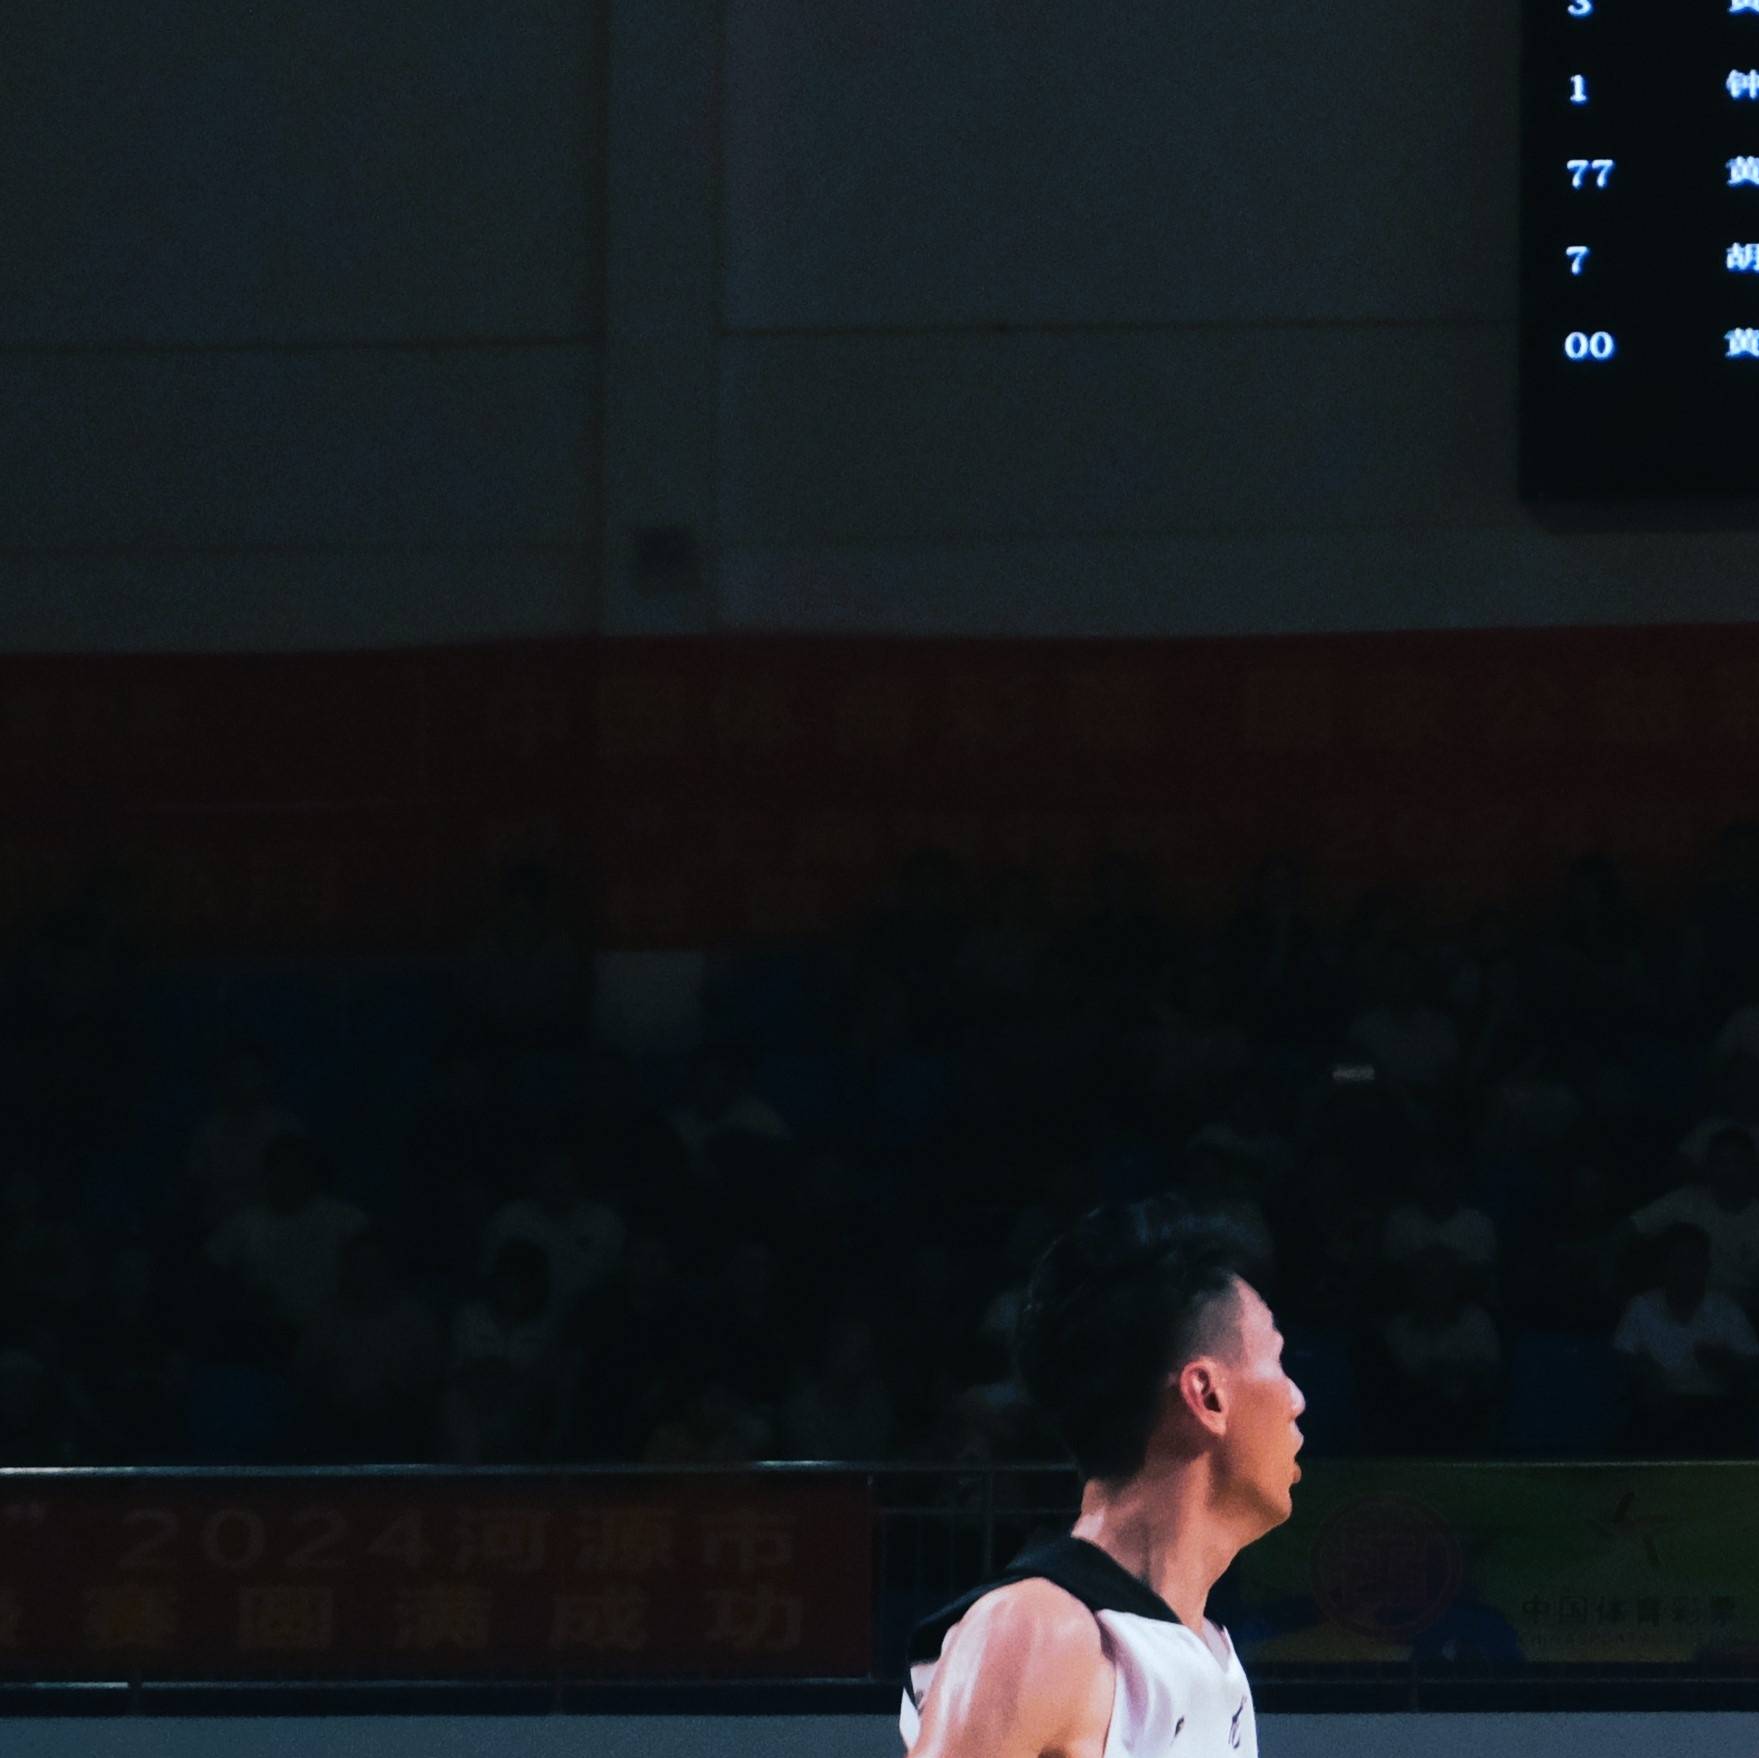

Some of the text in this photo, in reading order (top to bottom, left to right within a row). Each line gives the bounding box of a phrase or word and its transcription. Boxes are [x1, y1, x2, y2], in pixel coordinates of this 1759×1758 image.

[1570, 75, 1588, 103] 1
[1567, 159, 1615, 188] 77
[1566, 246, 1589, 275] 7
[1565, 331, 1615, 360] 00
